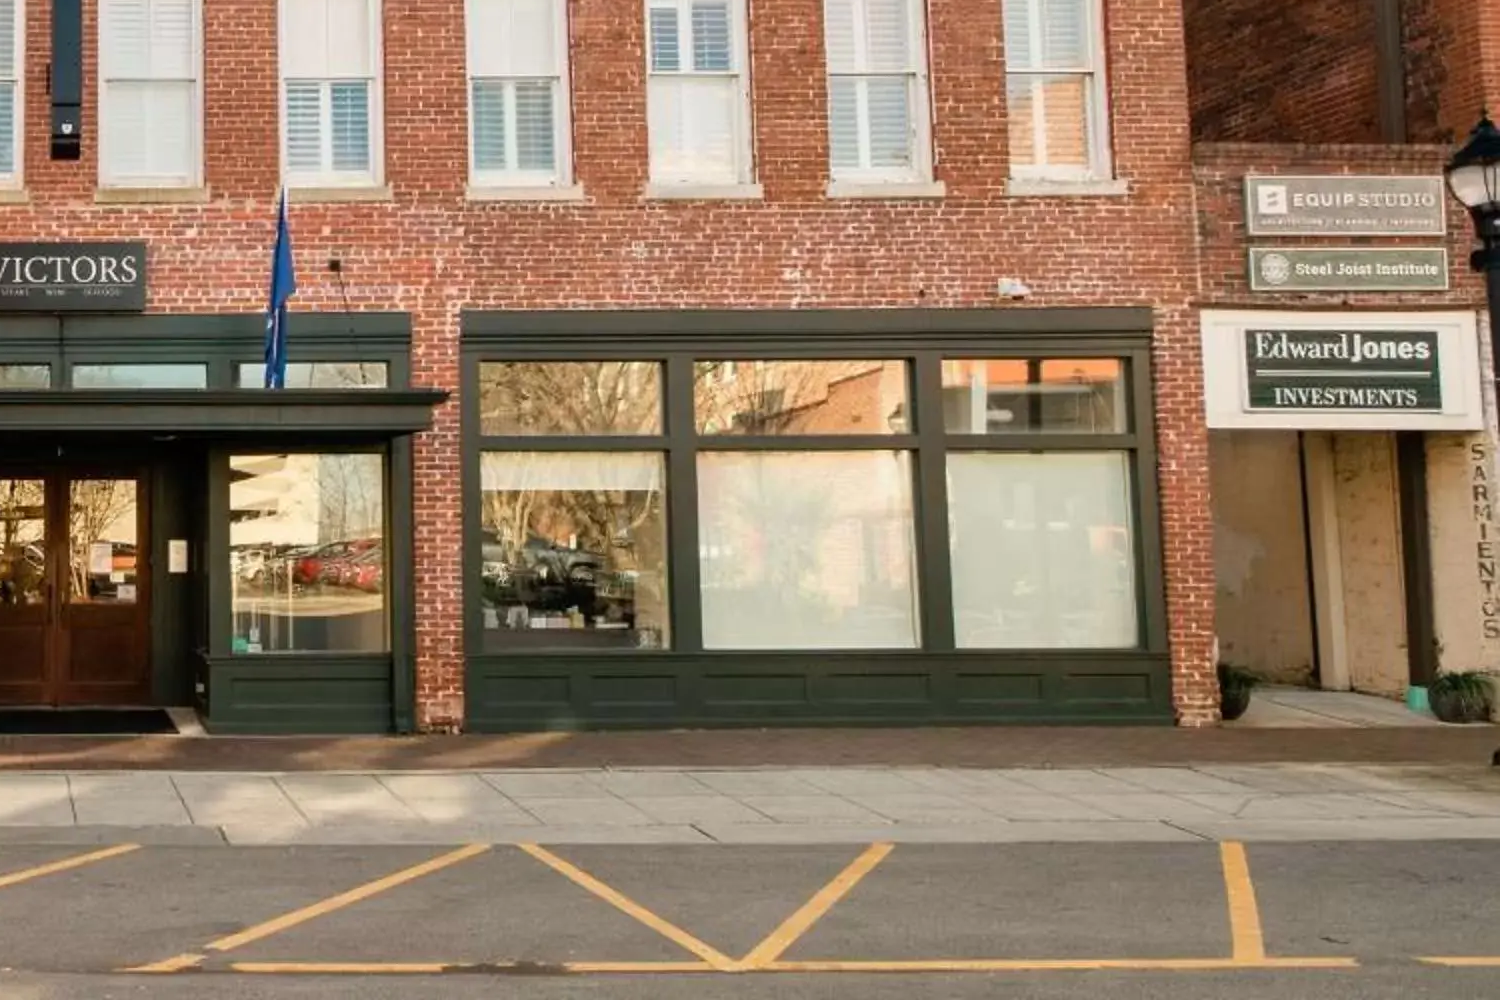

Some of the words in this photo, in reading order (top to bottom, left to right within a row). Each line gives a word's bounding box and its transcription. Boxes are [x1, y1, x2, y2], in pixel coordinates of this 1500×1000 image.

[1294, 262, 1332, 276] Steel
[1335, 262, 1373, 276] Joist
[1375, 262, 1440, 276] Institute
[1254, 331, 1348, 361] Edward
[1350, 333, 1431, 363] Jones
[1273, 386, 1418, 407] INVESTMENTS
[1470, 443, 1500, 640] SARMIENTOS
